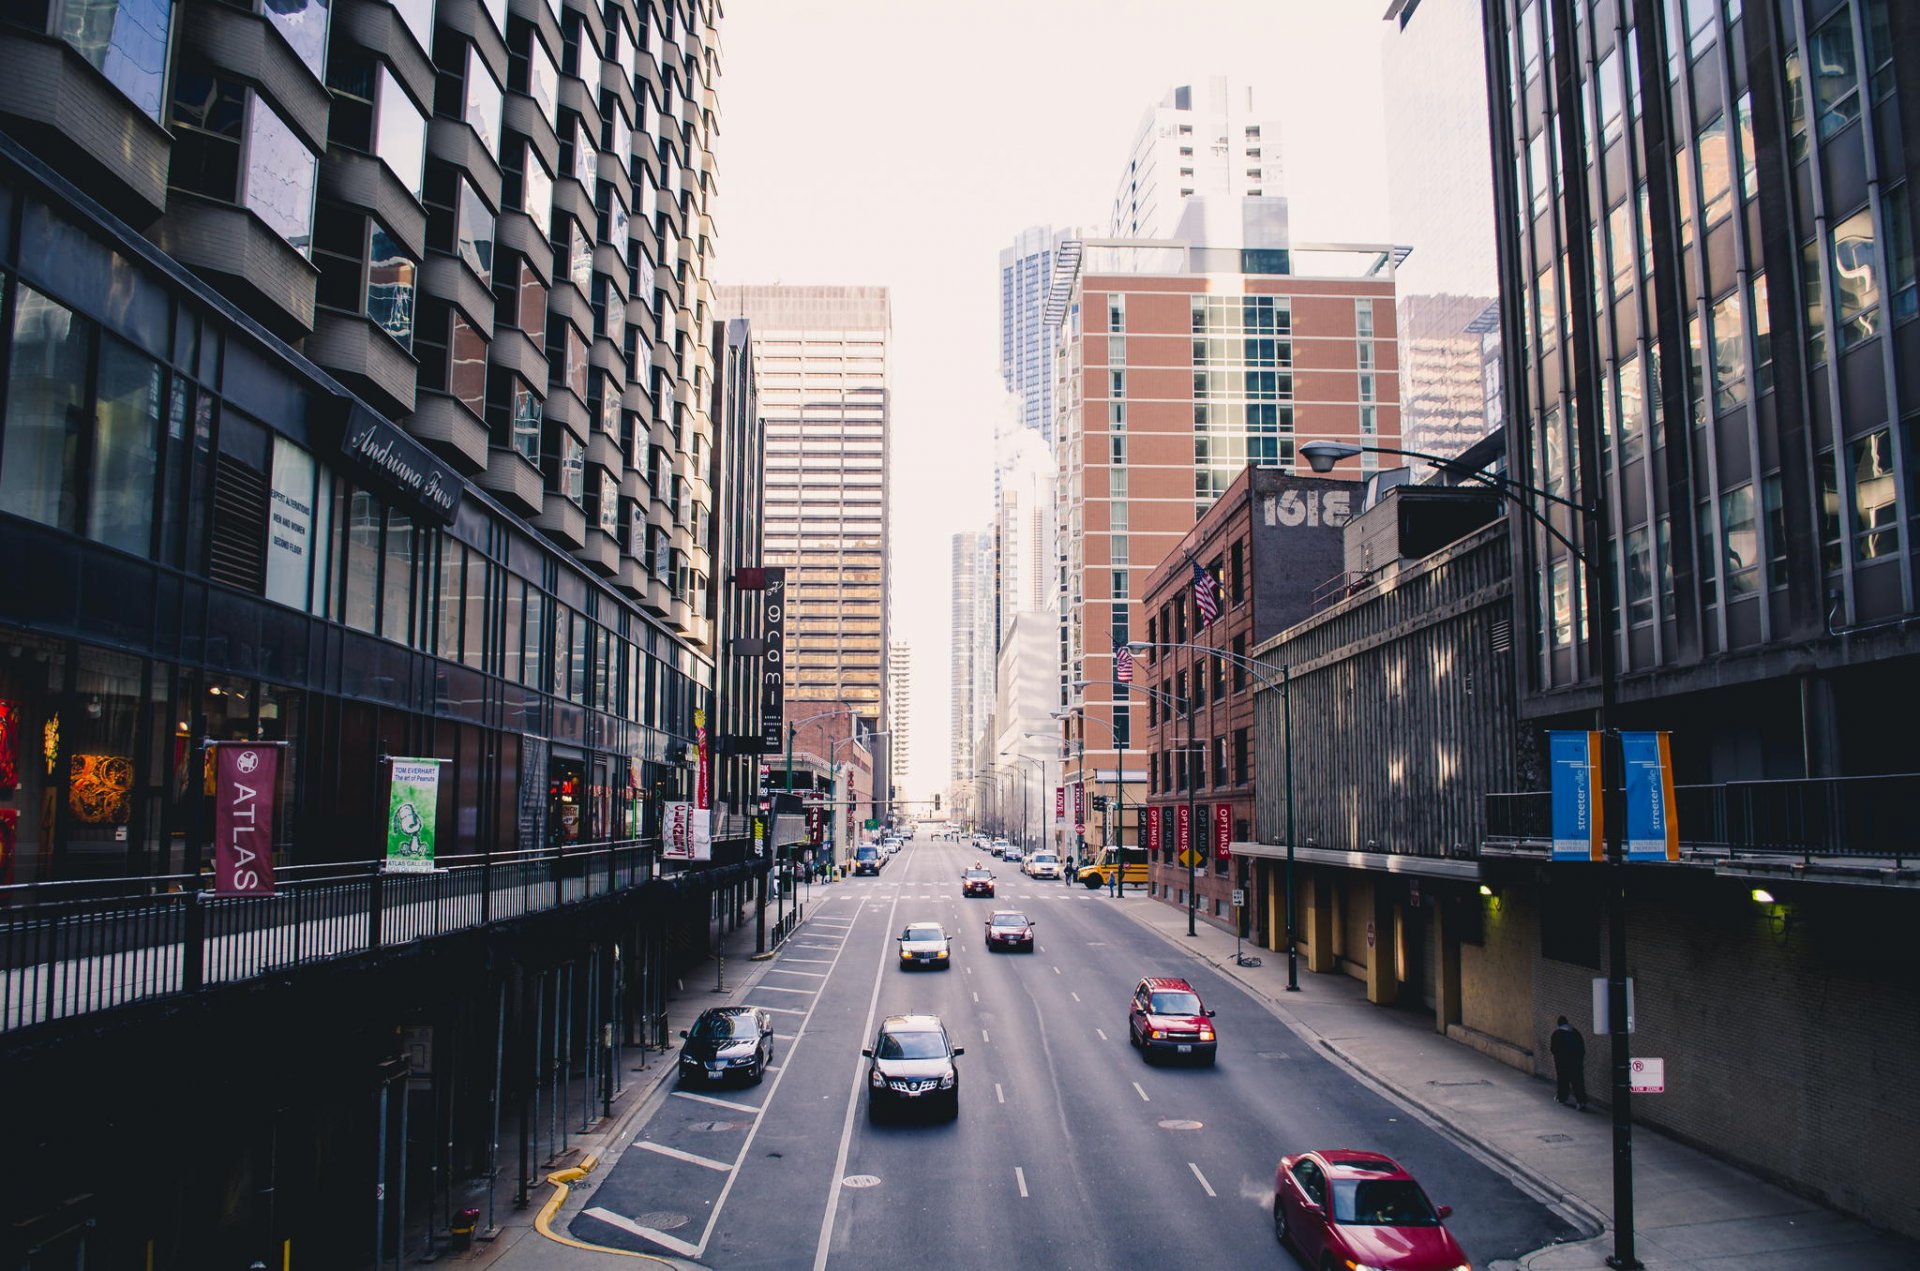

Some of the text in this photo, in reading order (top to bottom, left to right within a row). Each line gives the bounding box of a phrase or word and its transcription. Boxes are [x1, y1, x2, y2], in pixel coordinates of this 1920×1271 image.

[352, 425, 454, 509] Andriana Furs
[407, 767, 435, 775] EVERHART
[1575, 770, 1586, 830] streeterville
[1648, 769, 1660, 830] streeterville
[233, 782, 258, 890] ATLAS
[754, 818, 764, 857] SUBWAY
[1180, 809, 1188, 850] OPTIMUS
[1220, 808, 1228, 855] OPTIMUS
